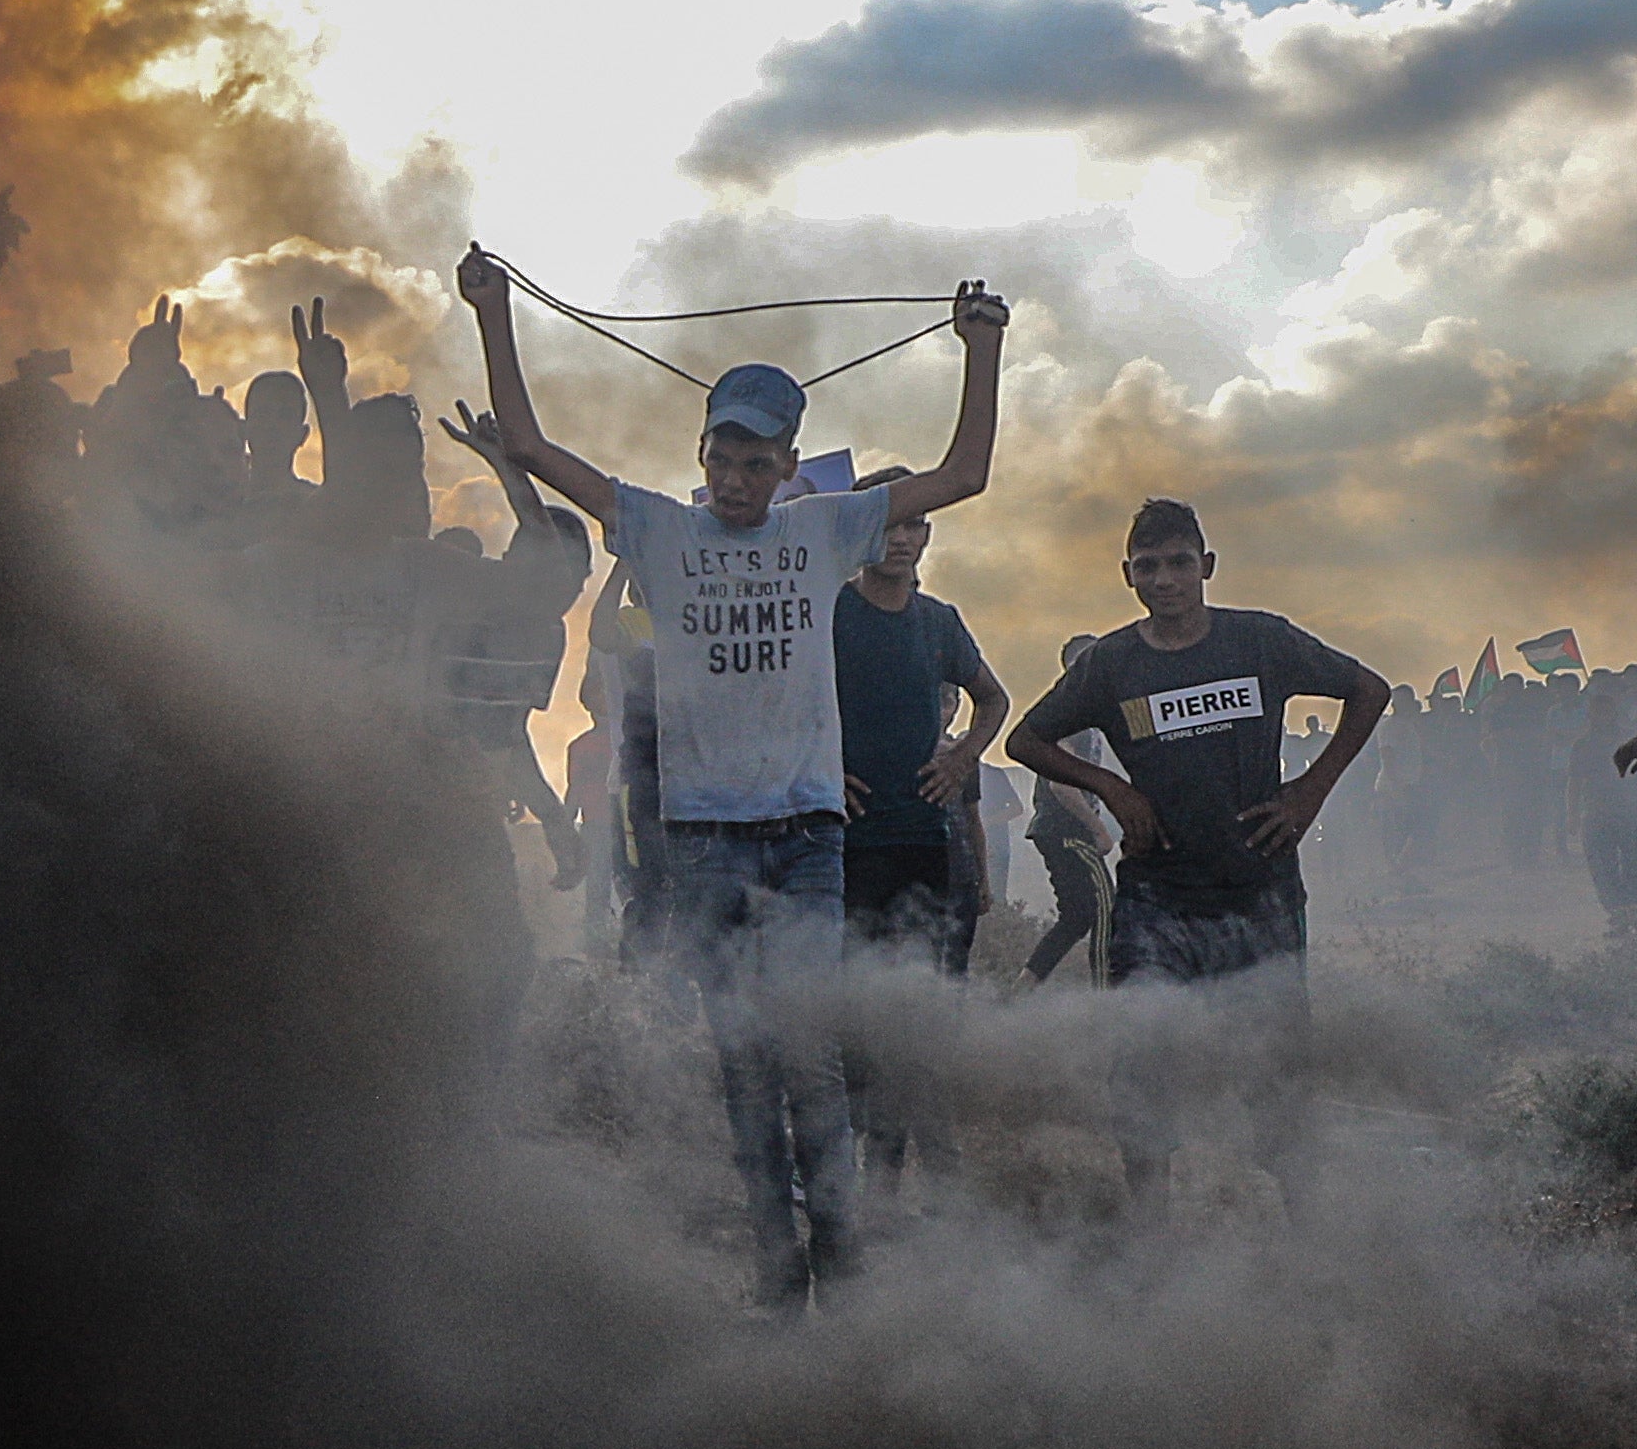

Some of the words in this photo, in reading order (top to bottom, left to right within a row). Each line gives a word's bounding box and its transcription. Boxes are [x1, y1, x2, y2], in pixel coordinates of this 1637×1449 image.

[682, 548, 761, 577] LET'S
[778, 546, 808, 572] GO
[698, 582, 727, 598] AND
[736, 579, 782, 598] ENJOY
[682, 597, 813, 636] SUMMER
[709, 638, 792, 674] SURF
[1160, 688, 1251, 721] PIERRE
